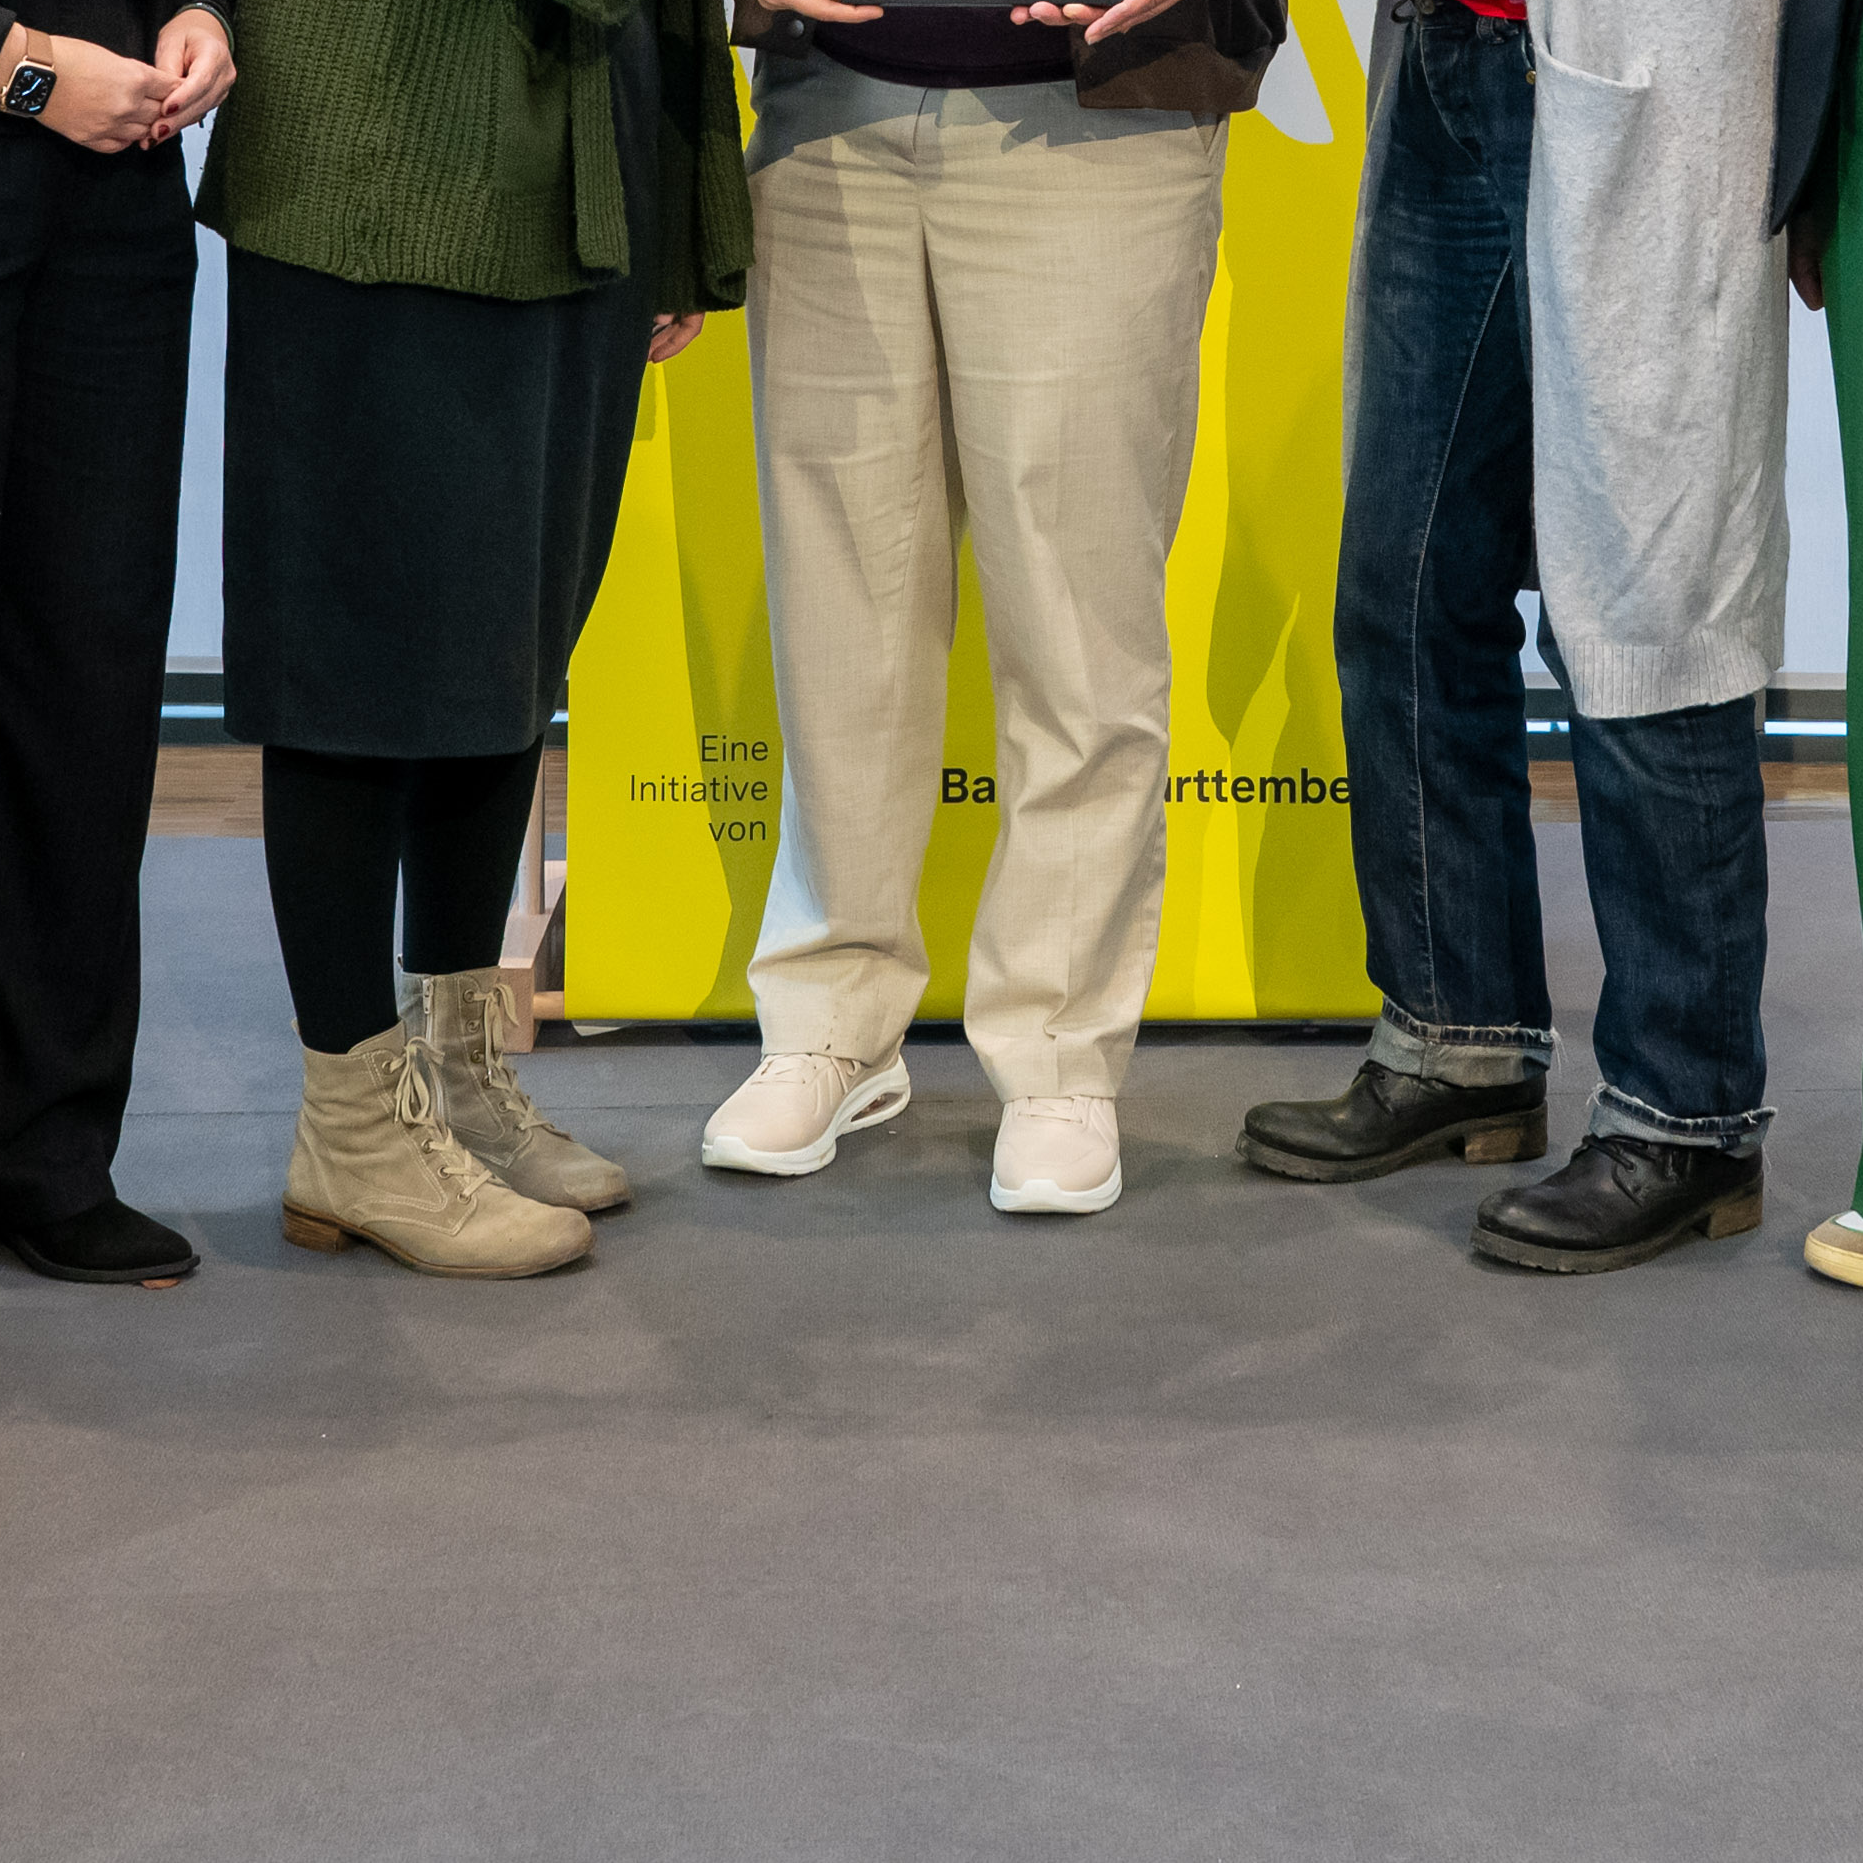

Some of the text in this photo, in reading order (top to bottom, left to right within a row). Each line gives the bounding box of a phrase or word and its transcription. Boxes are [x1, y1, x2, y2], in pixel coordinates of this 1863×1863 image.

[701, 734, 769, 763] Eine
[630, 774, 769, 803] Initiative
[708, 820, 767, 843] von
